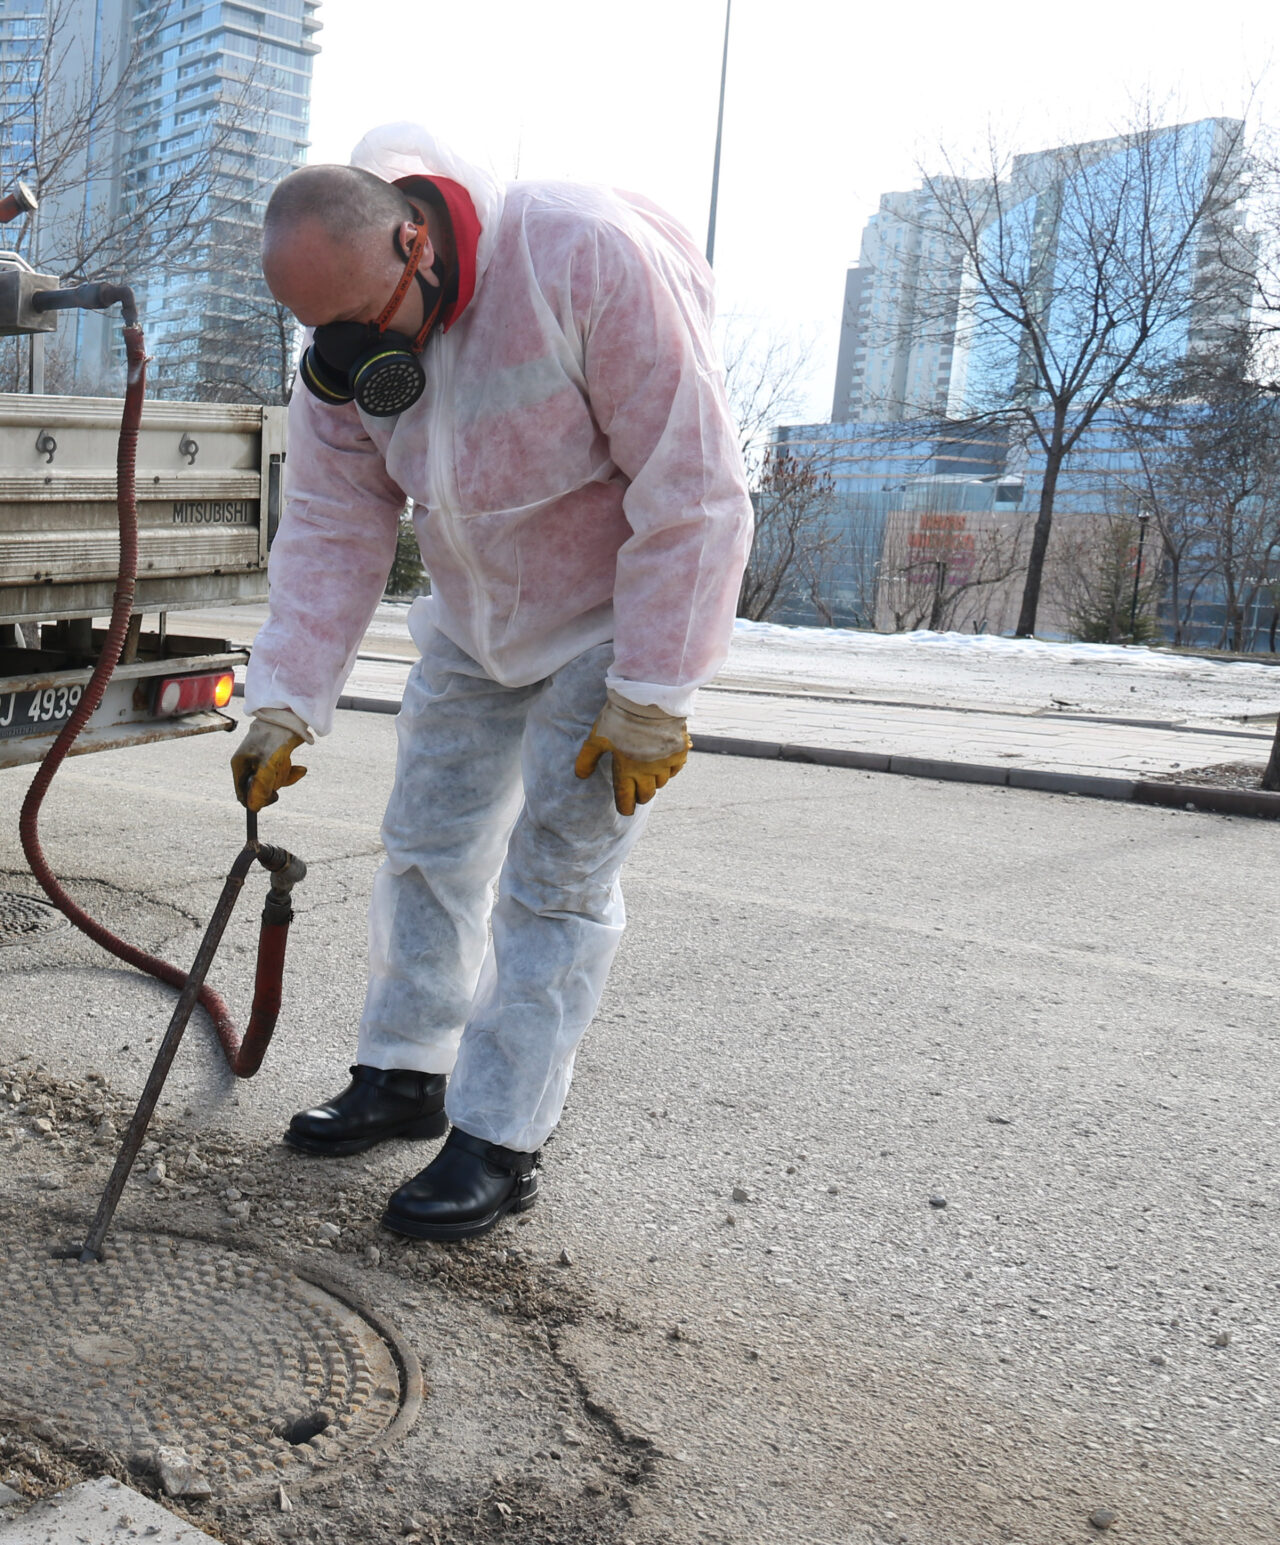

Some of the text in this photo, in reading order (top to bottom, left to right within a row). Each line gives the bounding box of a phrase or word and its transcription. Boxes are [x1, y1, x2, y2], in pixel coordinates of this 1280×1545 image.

[400, 280, 409, 290] IN
[173, 502, 248, 523] MITSUBISHI
[28, 685, 82, 722] 4939
